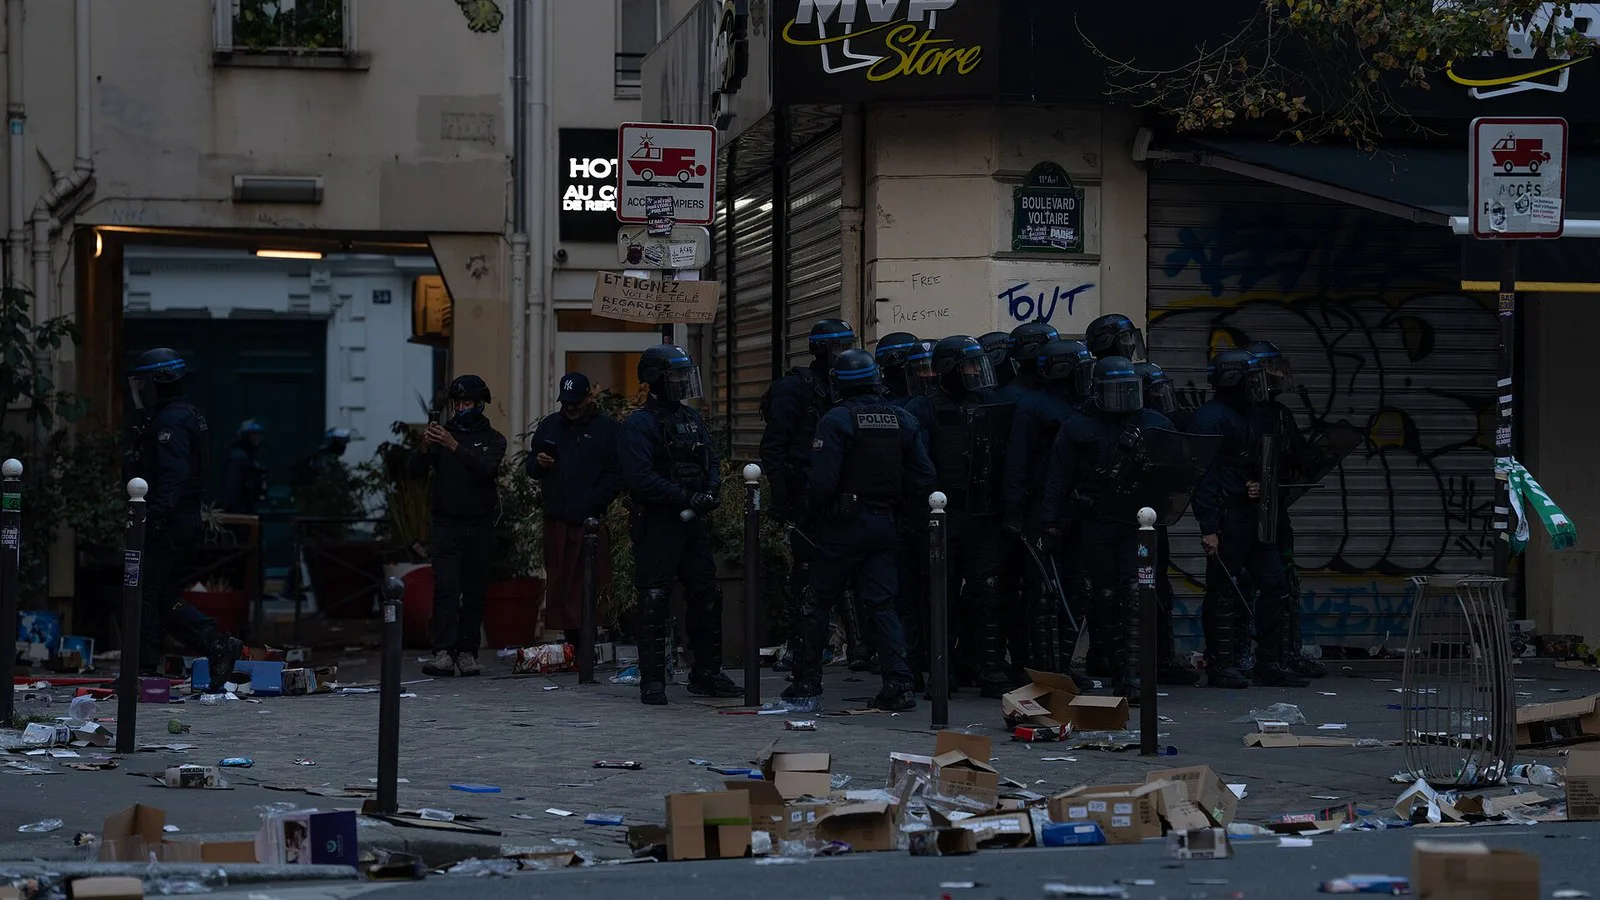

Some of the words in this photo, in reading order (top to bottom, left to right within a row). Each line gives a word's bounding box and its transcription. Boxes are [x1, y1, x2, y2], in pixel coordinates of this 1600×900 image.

[866, 23, 983, 82] Store
[562, 184, 594, 200] AU
[1022, 196, 1075, 210] BOULEVARD
[1028, 211, 1069, 225] VOLTAIRE
[911, 273, 941, 287] FREE
[602, 296, 672, 312] REGARDEZ
[998, 282, 1096, 324] TOUT
[892, 304, 950, 324] PALESTINE
[858, 414, 897, 424] POLICE
